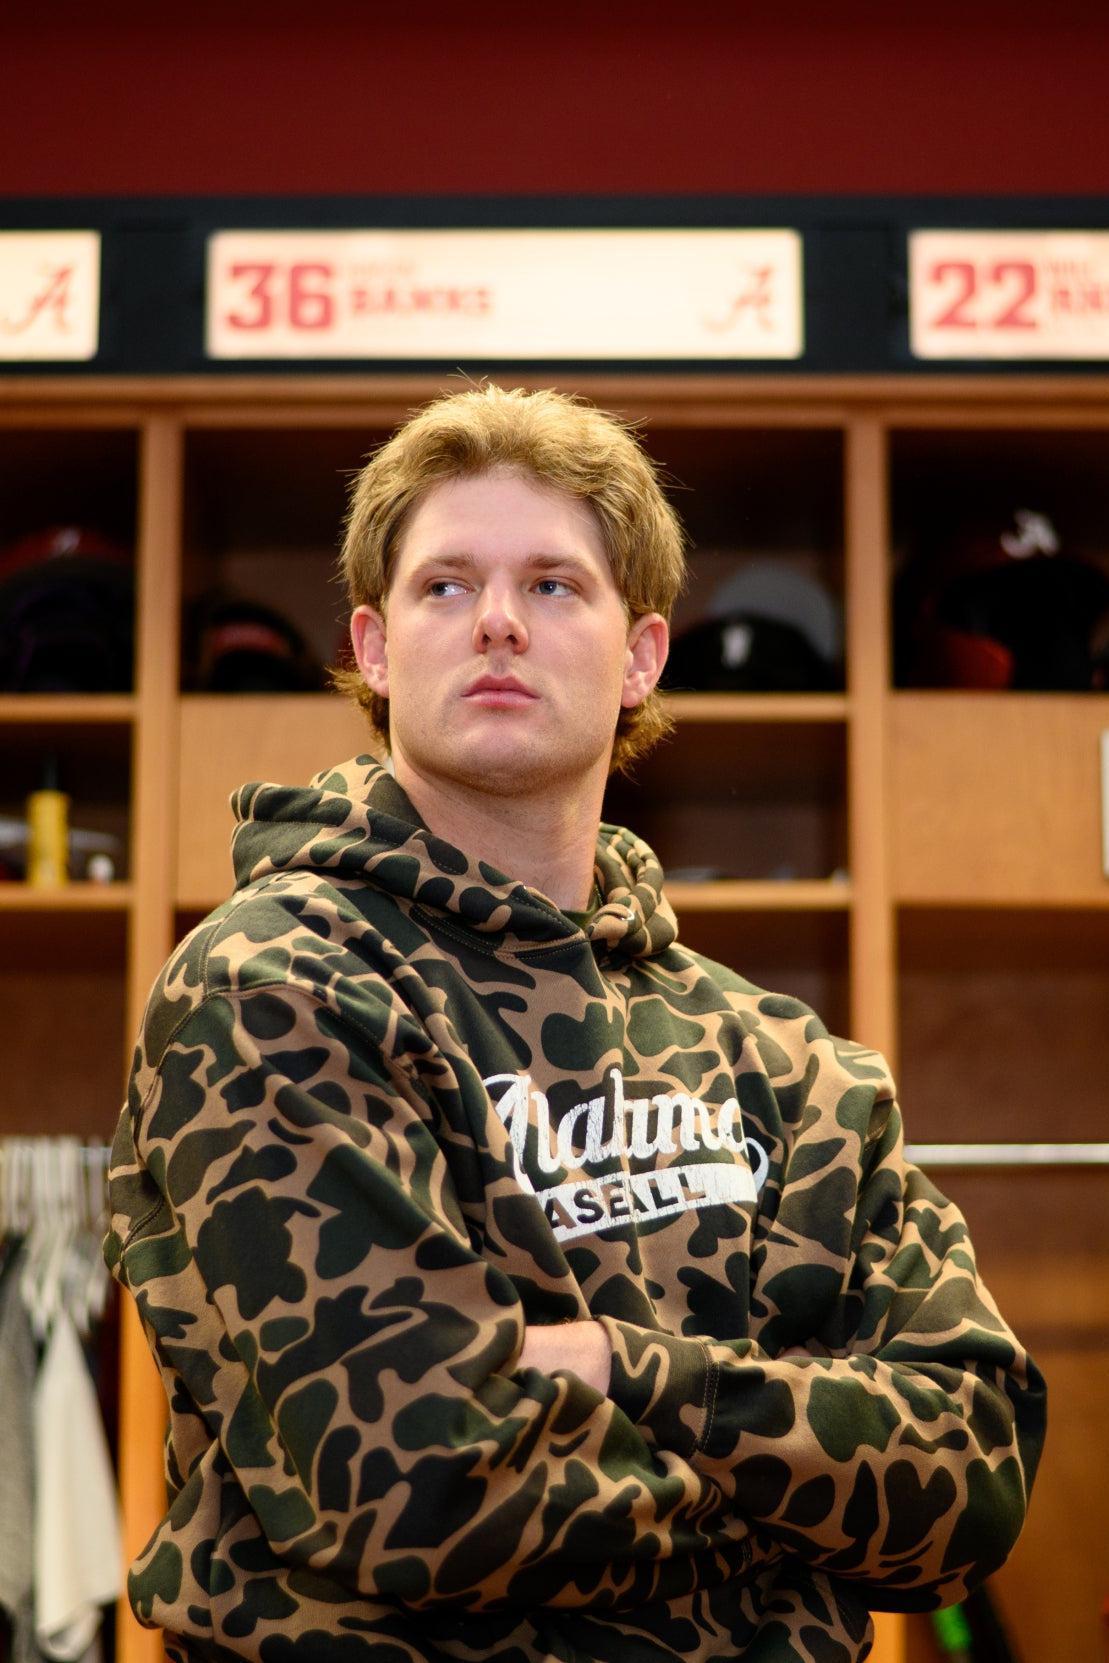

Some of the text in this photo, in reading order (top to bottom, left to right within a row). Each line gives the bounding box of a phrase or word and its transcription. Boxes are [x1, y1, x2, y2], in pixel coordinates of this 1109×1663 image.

[227, 263, 336, 331] 36
[931, 261, 1038, 330] 22
[544, 1172, 707, 1229] ASELL
